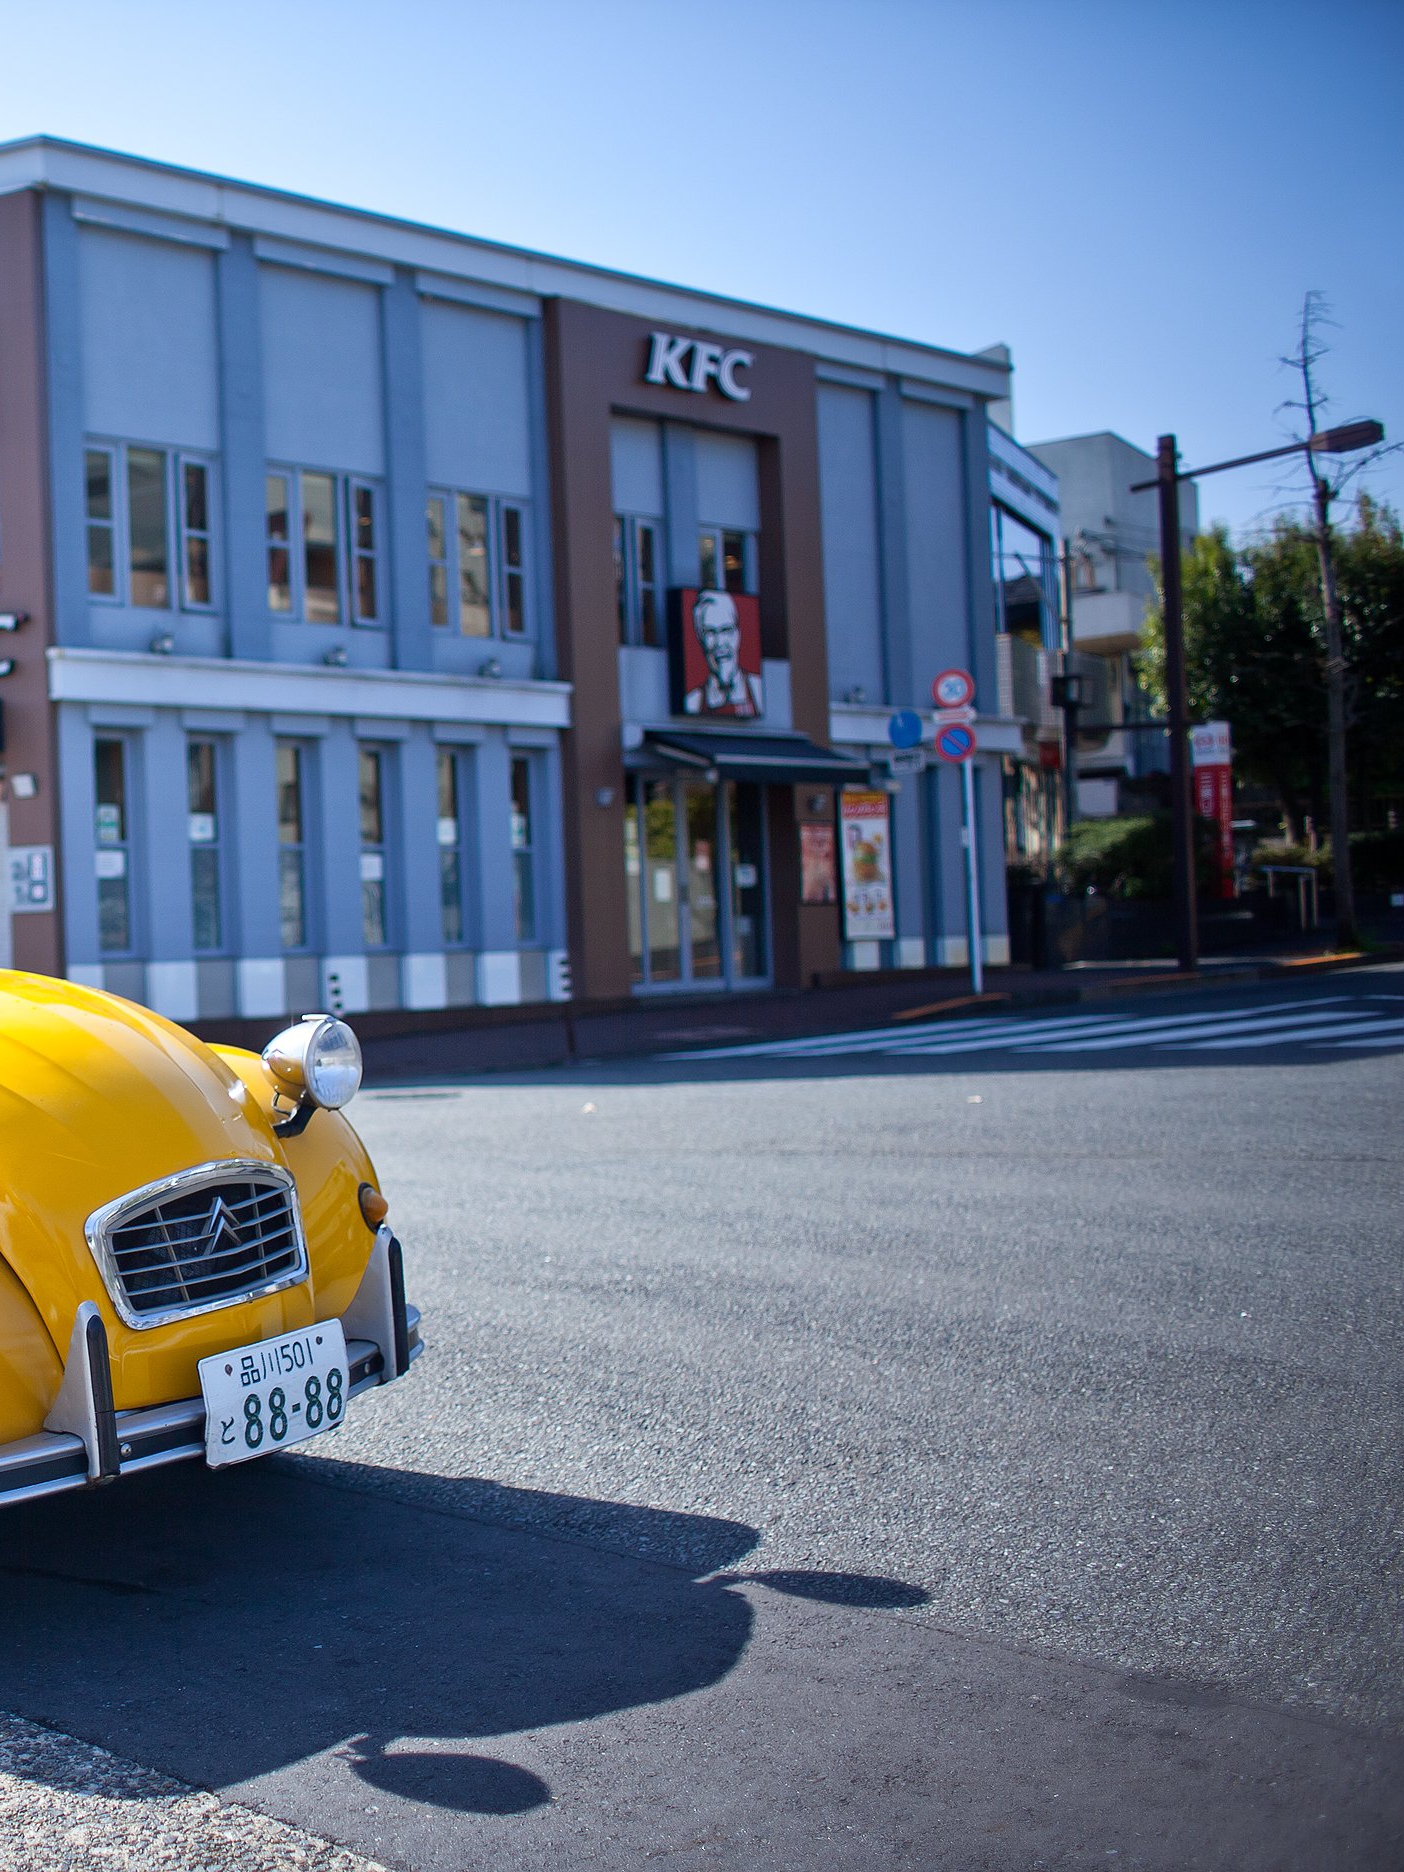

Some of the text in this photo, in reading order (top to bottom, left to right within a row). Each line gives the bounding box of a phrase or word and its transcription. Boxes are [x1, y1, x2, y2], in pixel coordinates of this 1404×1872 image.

[645, 331, 756, 402] KFC
[220, 1367, 343, 1449] と 88-88
